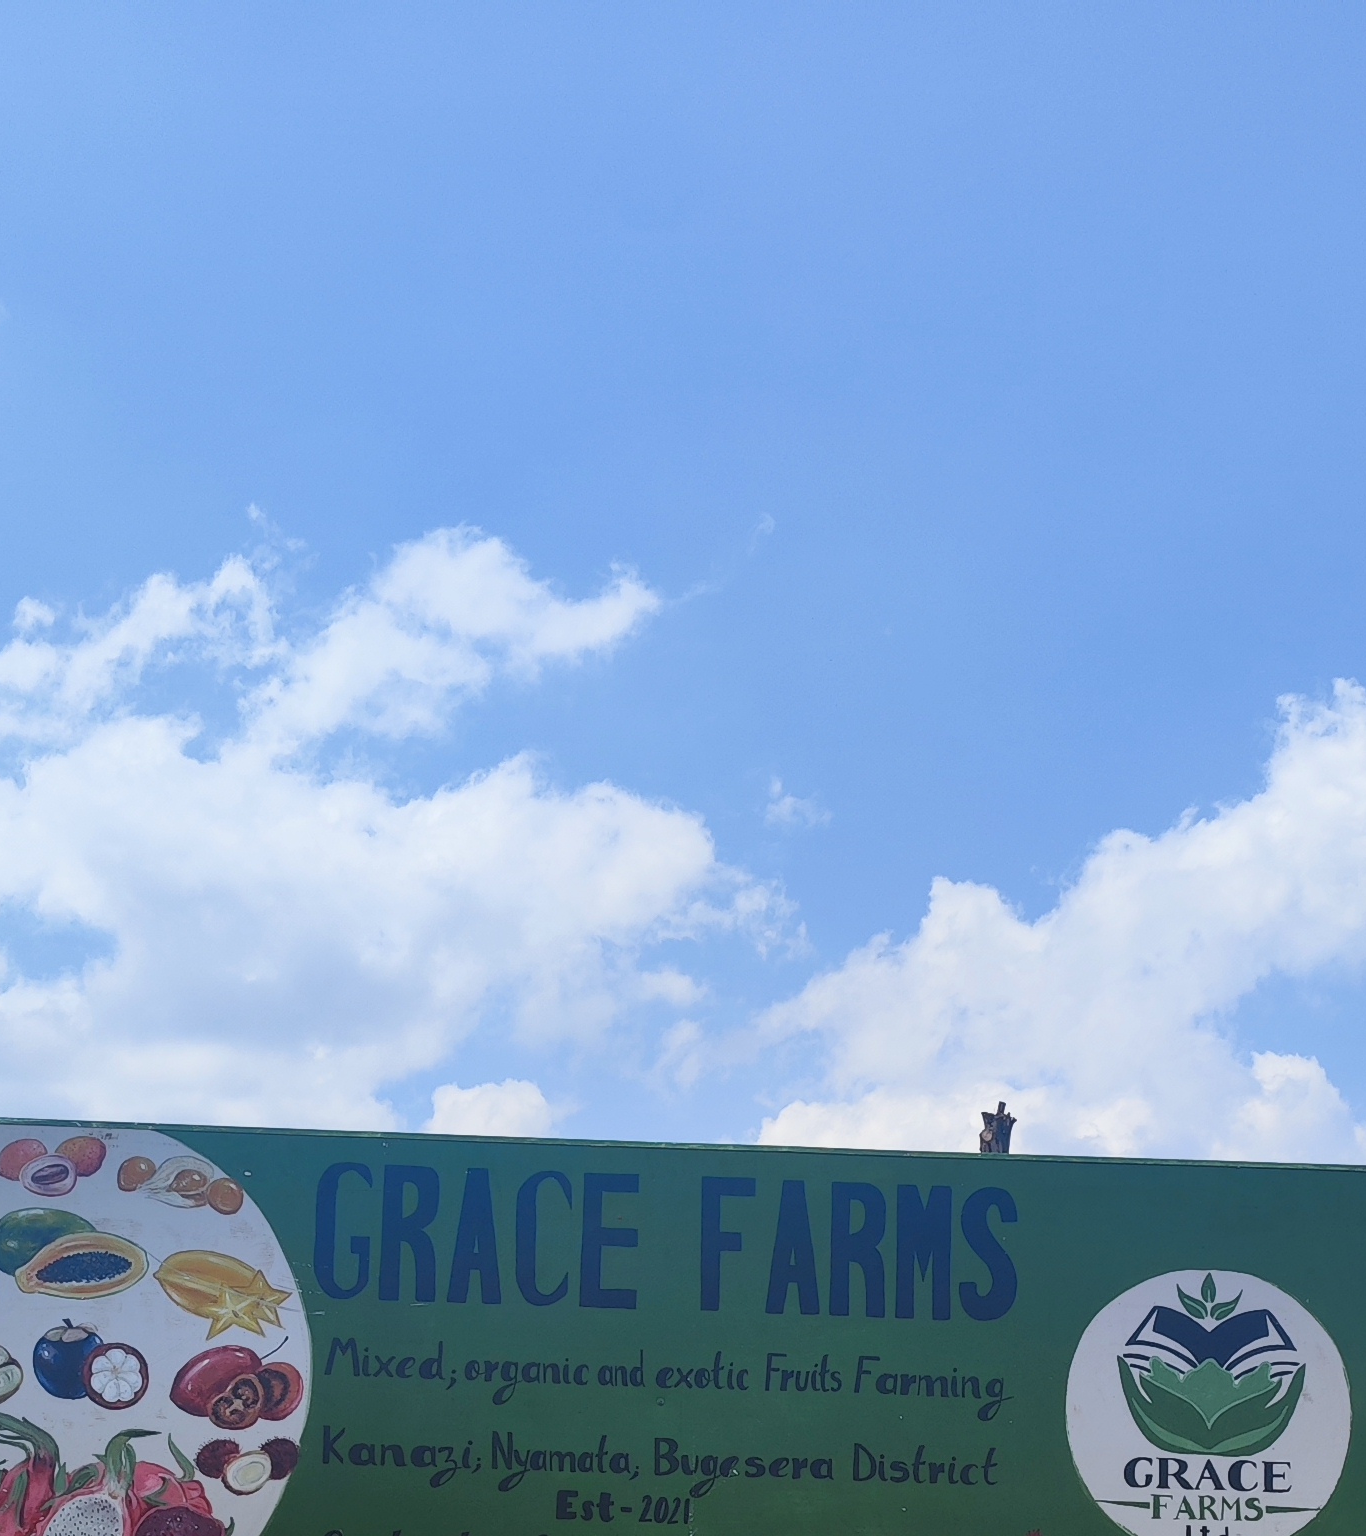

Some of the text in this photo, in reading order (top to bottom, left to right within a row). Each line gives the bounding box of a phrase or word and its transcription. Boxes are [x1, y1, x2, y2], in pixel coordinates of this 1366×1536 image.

[313, 1161, 1018, 1322] GRACE FARMS
[463, 1357, 590, 1406] organic
[596, 1348, 646, 1388] and
[654, 1350, 750, 1391] exotic
[763, 1352, 843, 1393] Fruits
[853, 1355, 1015, 1422] Farming
[653, 1436, 835, 1499] Bugesera
[852, 1442, 999, 1486] District
[1123, 1456, 1292, 1493] GRACE
[1150, 1493, 1264, 1522] FARMS
